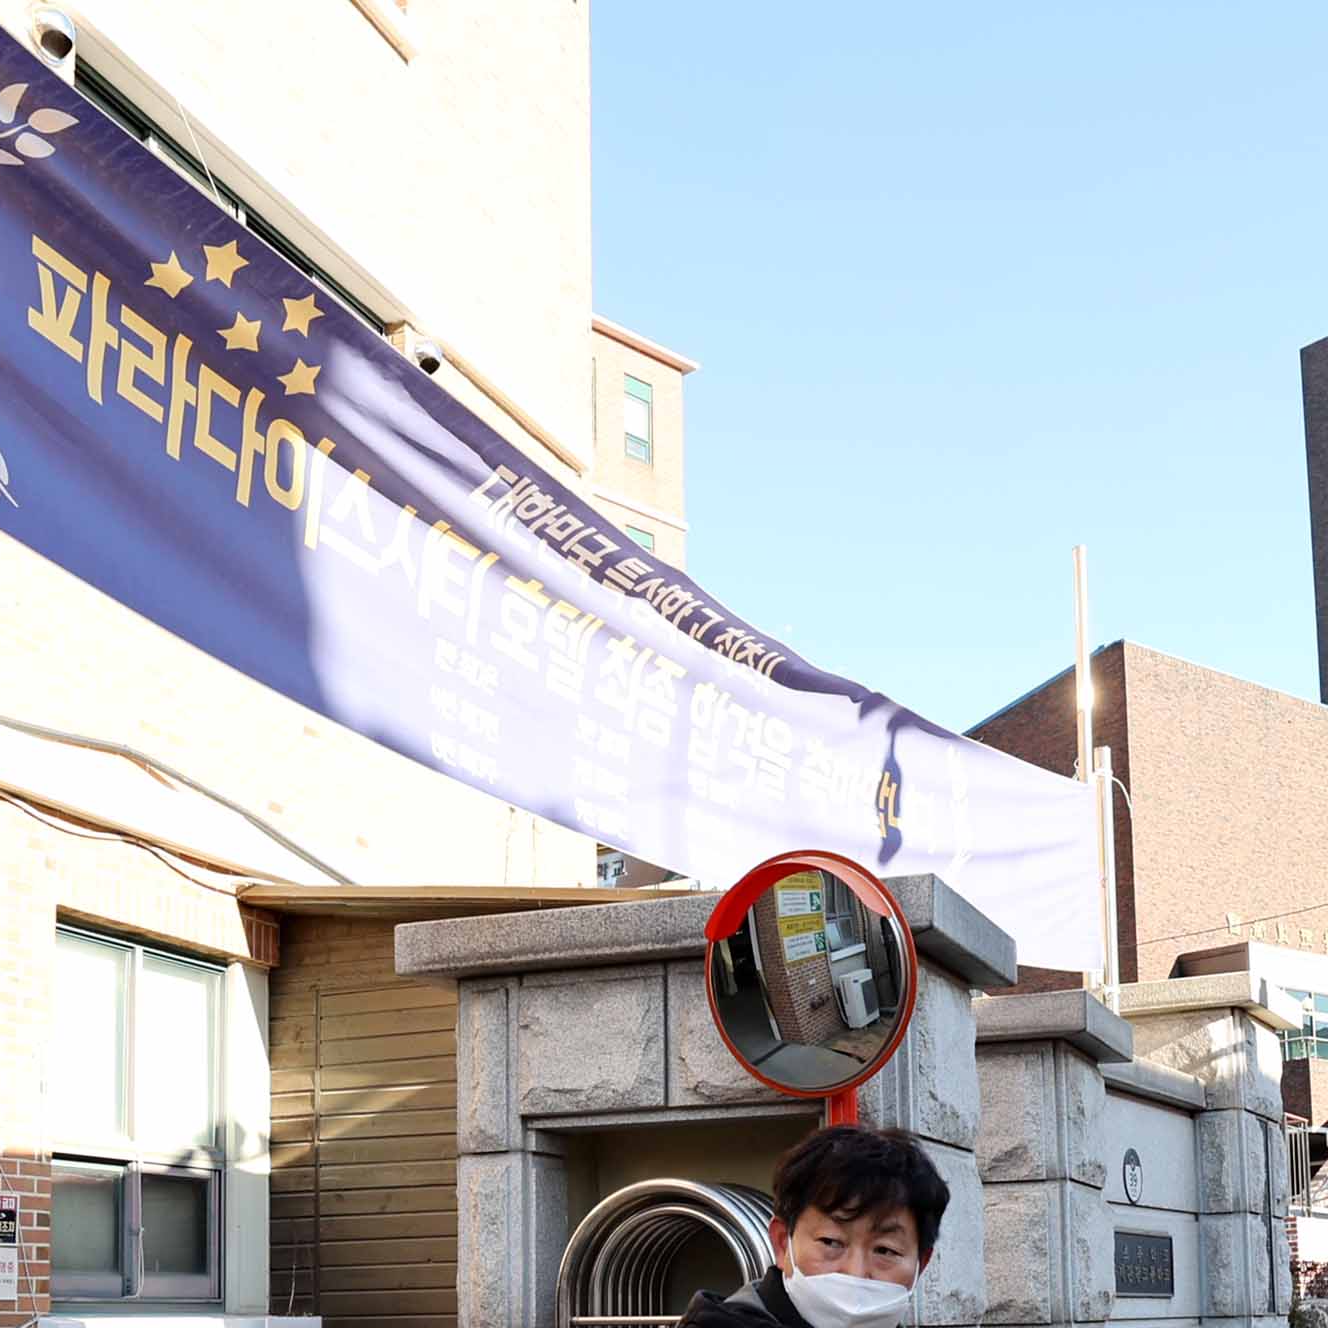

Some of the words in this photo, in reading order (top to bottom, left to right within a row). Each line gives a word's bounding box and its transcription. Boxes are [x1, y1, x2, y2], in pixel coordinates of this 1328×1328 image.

[27, 234, 500, 645] 파라다이스시티
[488, 575, 604, 705] 호텔
[471, 464, 622, 582] 대한민국
